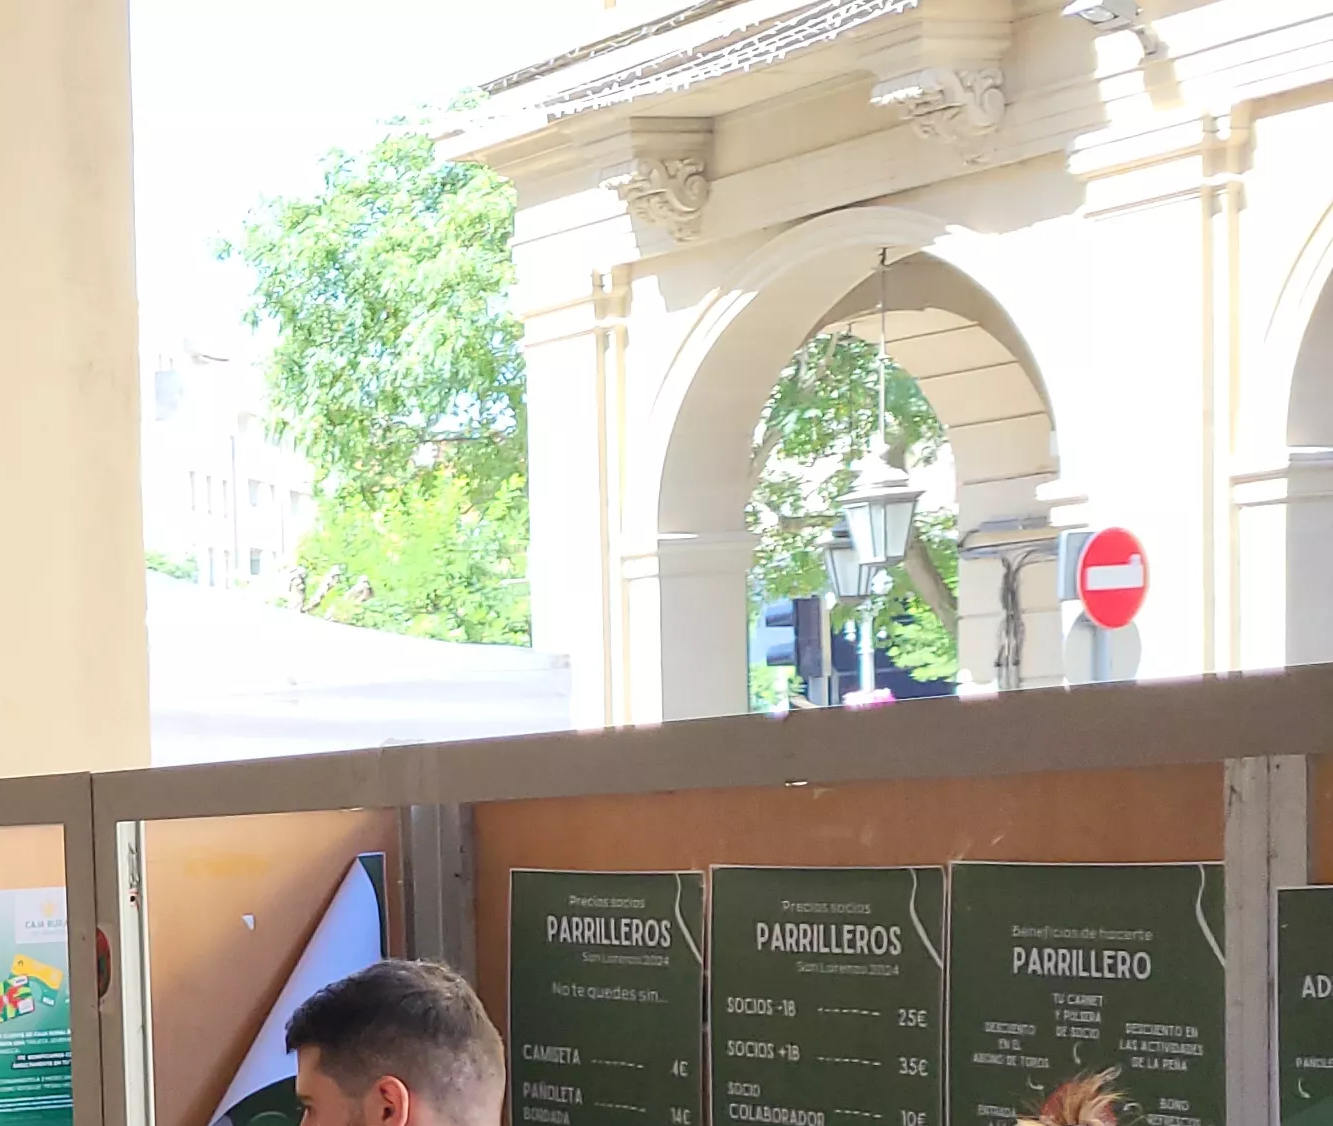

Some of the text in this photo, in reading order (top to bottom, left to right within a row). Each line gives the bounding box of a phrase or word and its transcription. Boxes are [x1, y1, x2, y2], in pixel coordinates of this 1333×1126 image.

[546, 915, 672, 947] PARRILLEROS
[756, 922, 902, 955] PARRILLEROS
[1012, 947, 1152, 980] PARRILLERO
[552, 982, 569, 996] No
[587, 986, 638, 1001] quedes
[1301, 974, 1333, 998] AD
[727, 996, 773, 1016] SOCIOS
[898, 1008, 928, 1028] 25€
[523, 1044, 689, 1077] CAMISETA 4€
[727, 1040, 774, 1060] SOCIOS
[898, 1057, 928, 1076] 35€
[523, 1081, 583, 1105] PAÑOLETA
